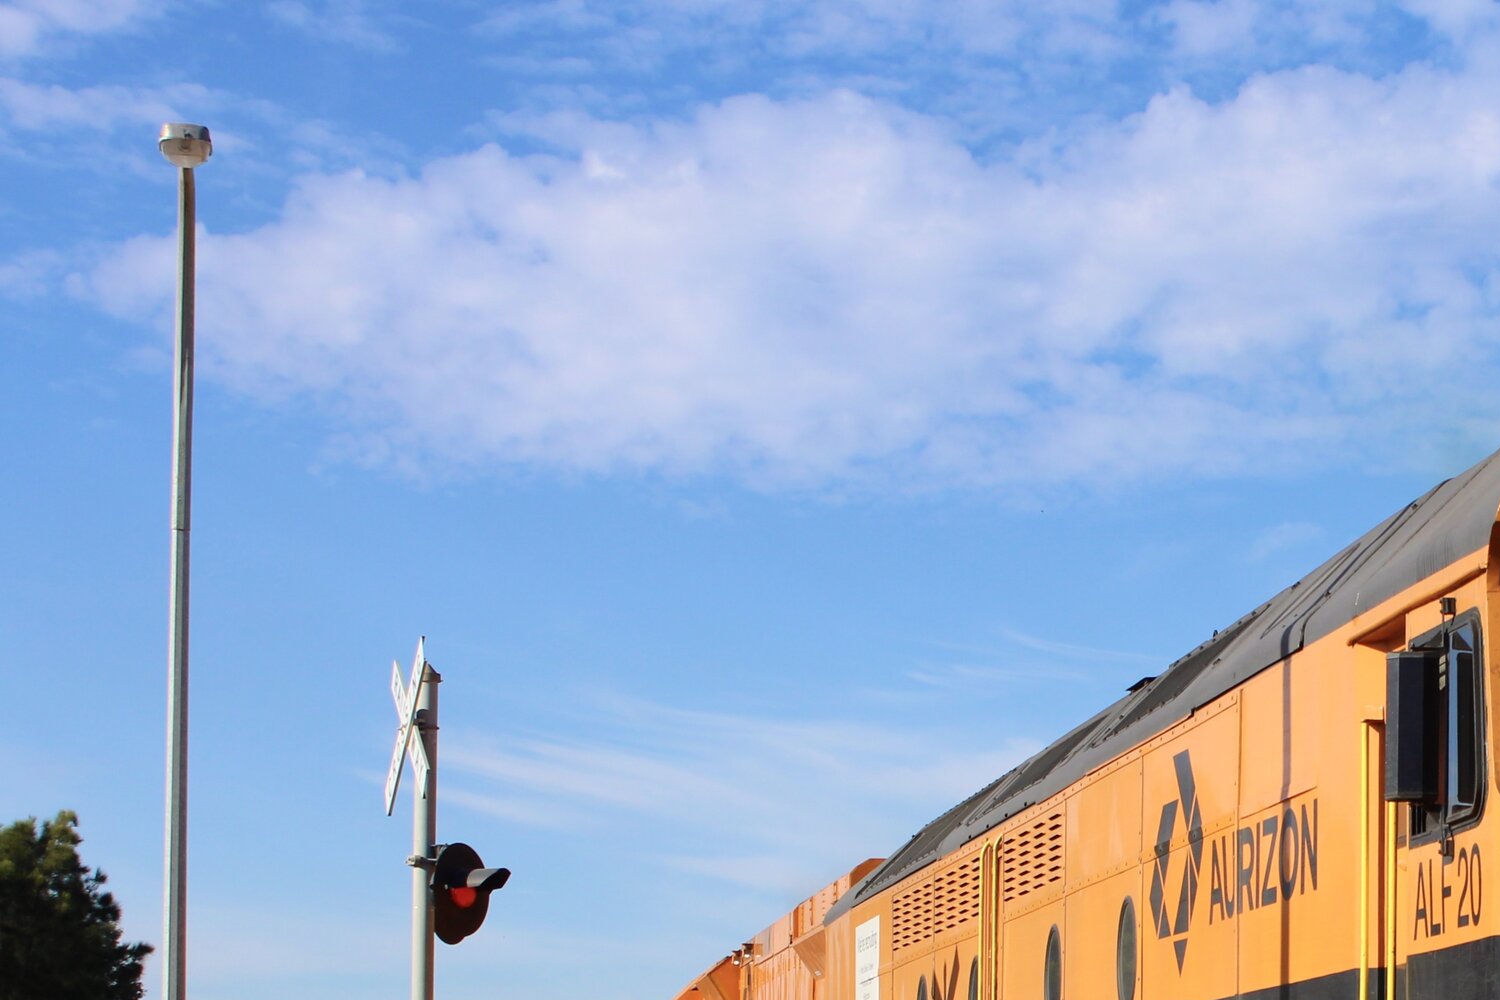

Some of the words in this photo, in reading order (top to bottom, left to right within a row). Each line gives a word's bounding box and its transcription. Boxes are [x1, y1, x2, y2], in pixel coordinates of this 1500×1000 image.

[1208, 798, 1318, 926] AURIZON
[1413, 856, 1453, 941] ALF
[1457, 842, 1482, 928] 20
